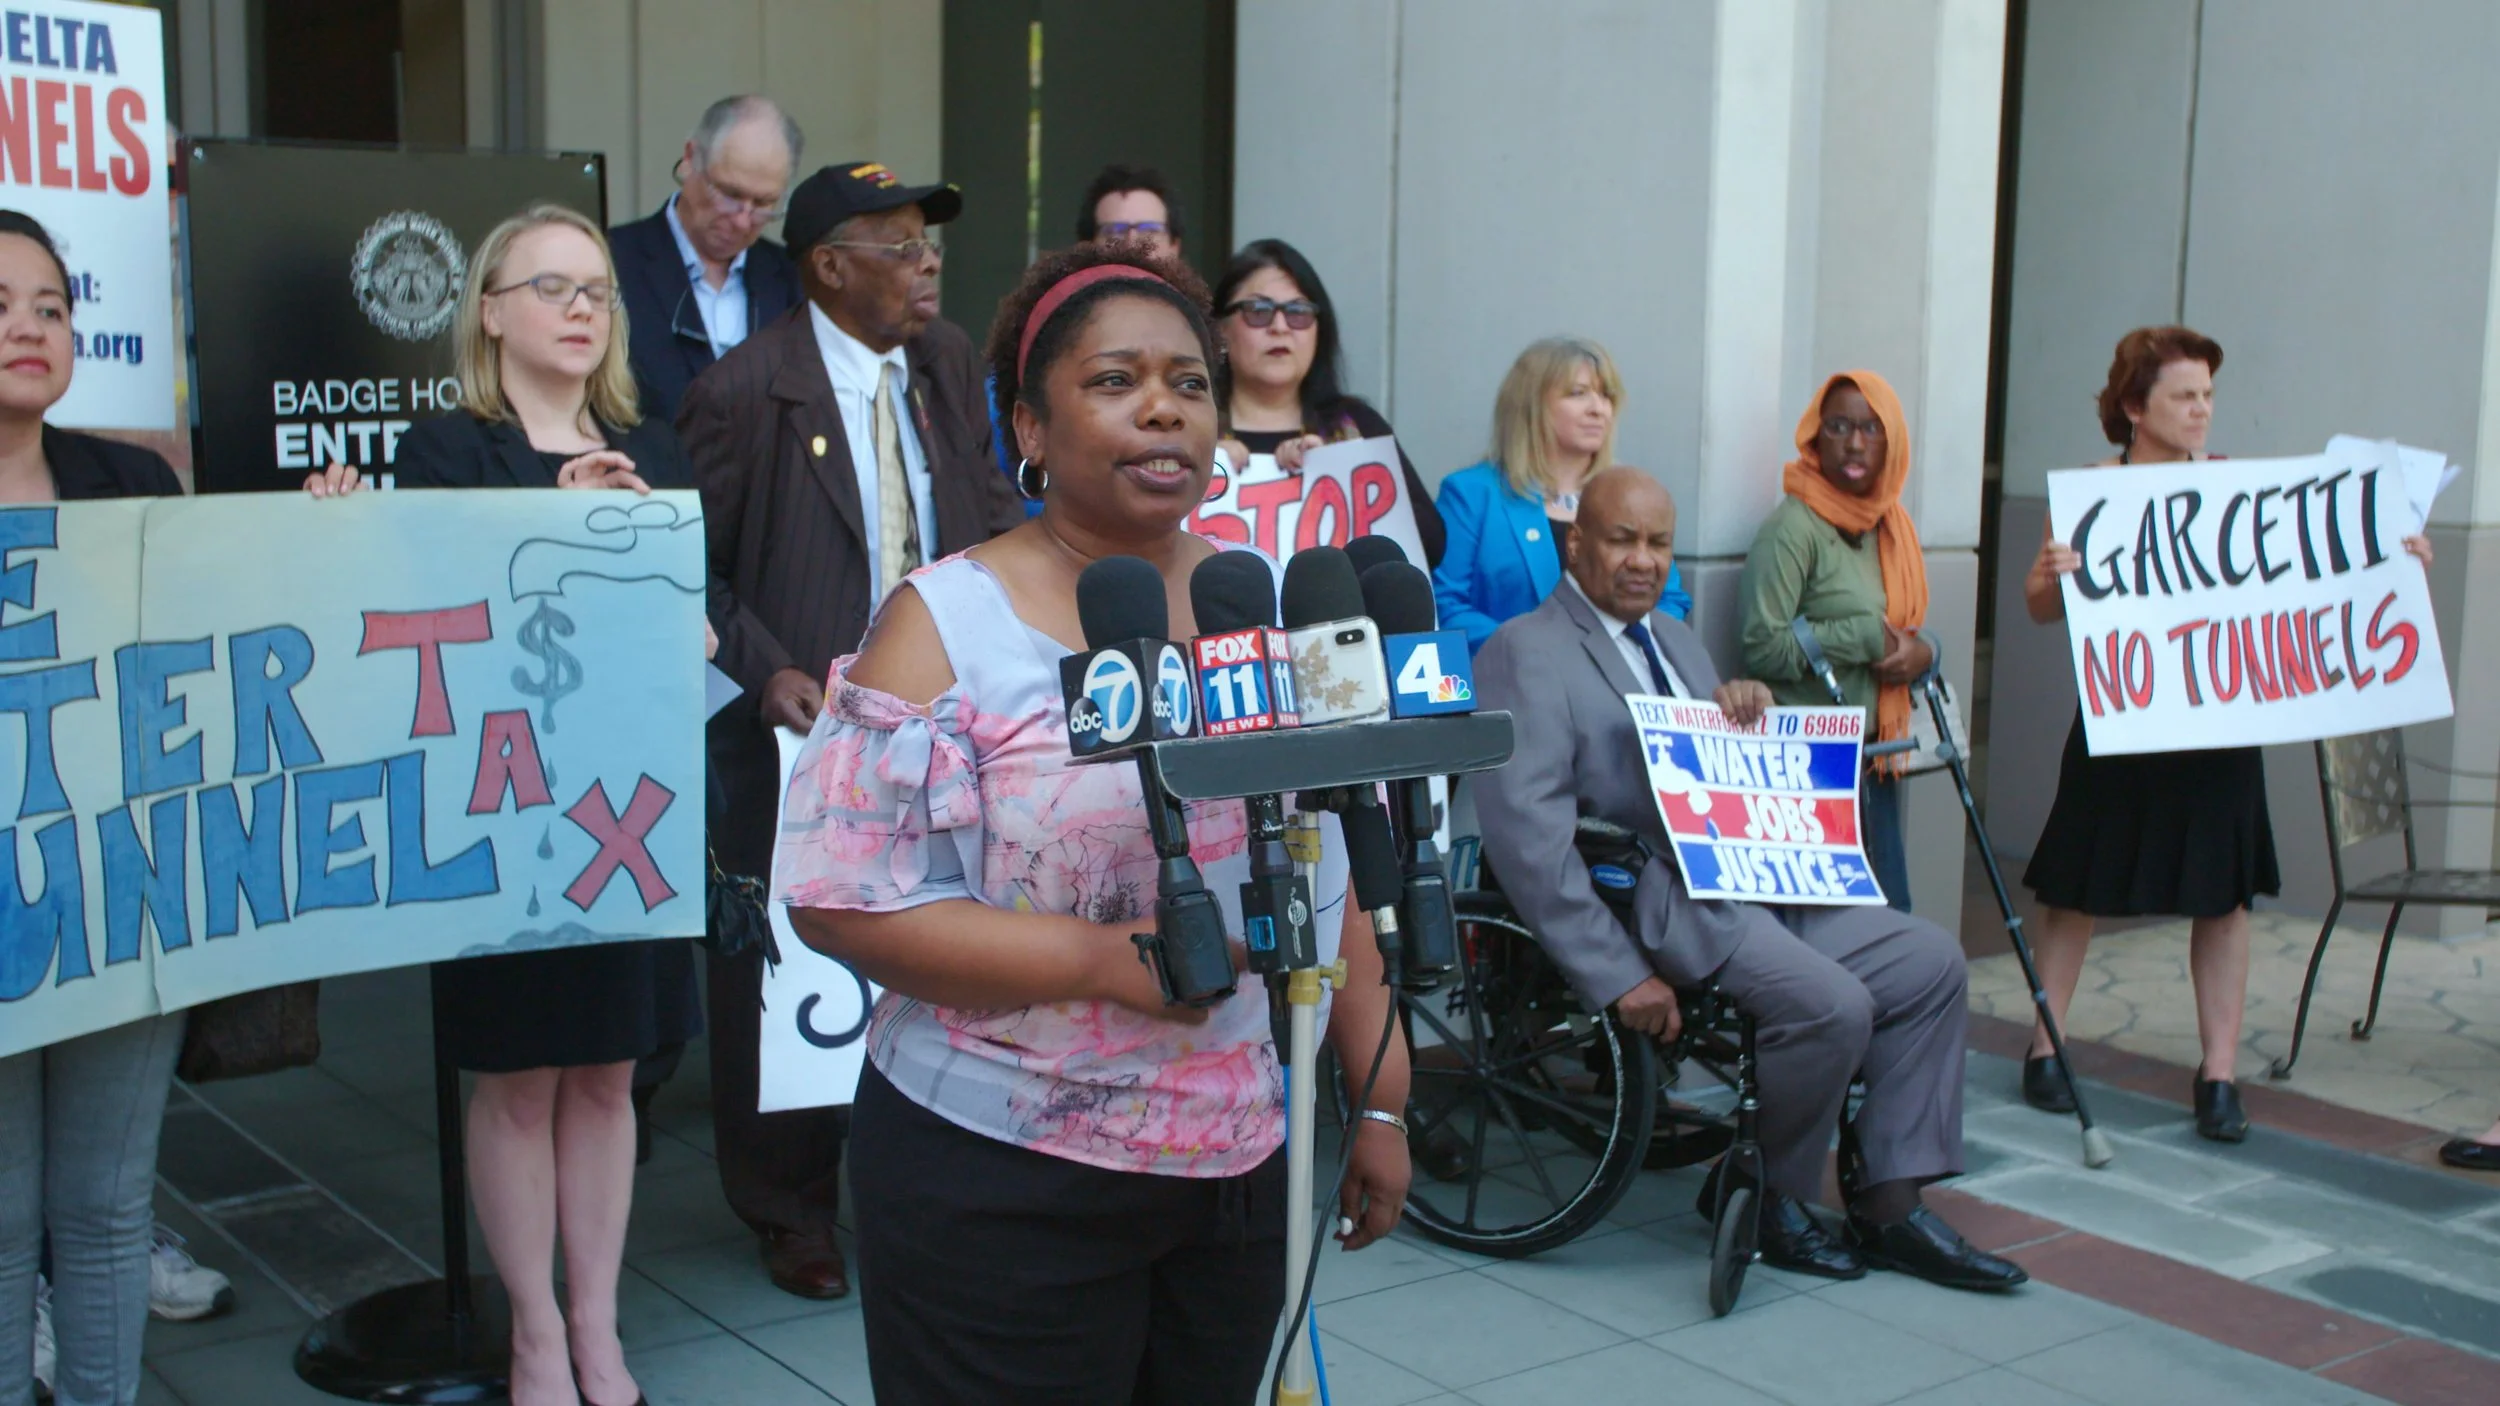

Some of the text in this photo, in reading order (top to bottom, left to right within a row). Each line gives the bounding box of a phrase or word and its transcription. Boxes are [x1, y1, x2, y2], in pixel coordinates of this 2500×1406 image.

[0, 11, 118, 76] ELTA
[0, 75, 151, 198] NELS
[273, 376, 463, 416] BADGE HO
[1188, 462, 1398, 560] STOP
[2070, 466, 2390, 601] GARCETTI
[1200, 633, 1260, 667] FOX
[1267, 631, 1290, 659] FOX
[2084, 590, 2420, 717] NO TUNNELS
[1085, 654, 1141, 740] 7
[1159, 652, 1190, 734] 7
[1209, 664, 1260, 720] 11
[1274, 661, 1295, 713] 11
[1397, 643, 1442, 704] 4
[0, 623, 324, 820] TER
[1070, 710, 1103, 734] abc
[1153, 700, 1172, 718] abc
[1211, 716, 1269, 735] NEWS
[1634, 702, 1668, 725] TEXT
[1777, 714, 1798, 736] TO
[1804, 714, 1860, 736] 69866
[1690, 733, 1813, 790] WATER
[1742, 793, 1825, 844] JOBS
[0, 750, 500, 1000] UNNEL
[1711, 844, 1848, 896] JUSTICE
